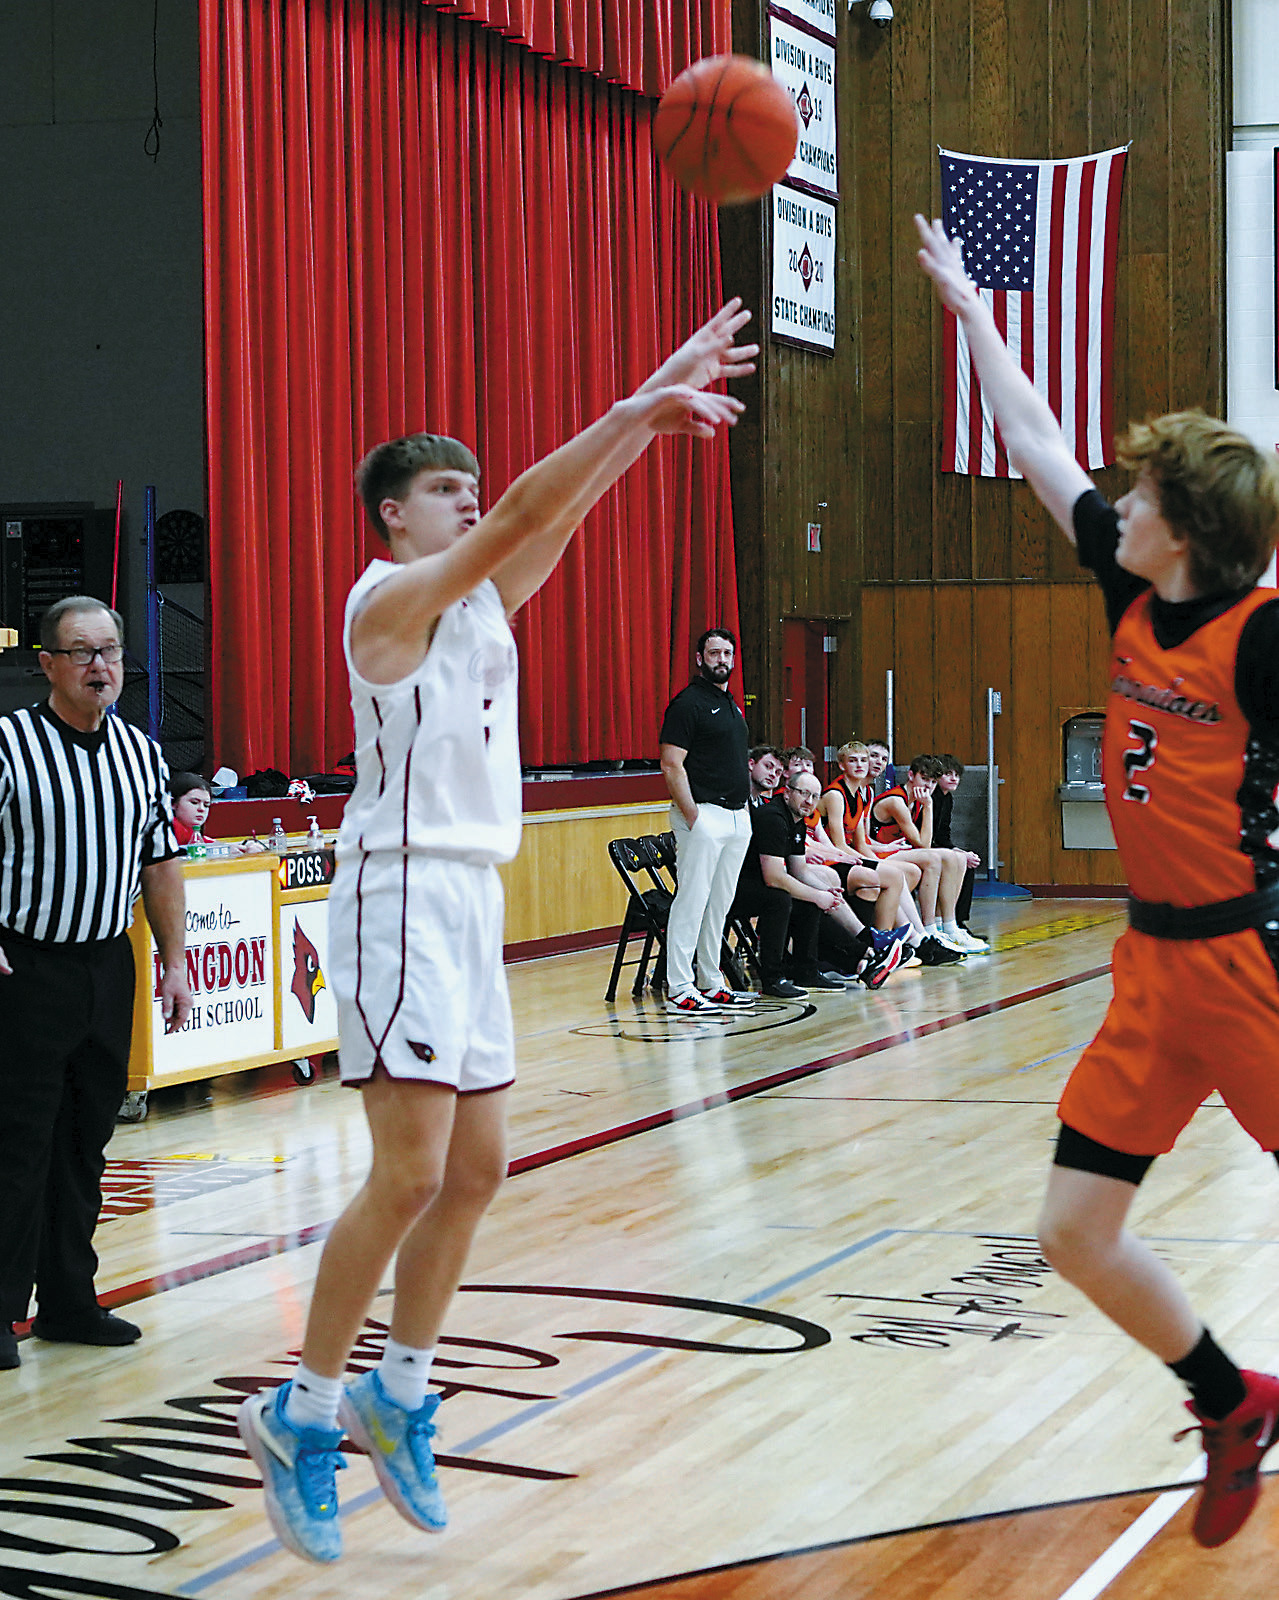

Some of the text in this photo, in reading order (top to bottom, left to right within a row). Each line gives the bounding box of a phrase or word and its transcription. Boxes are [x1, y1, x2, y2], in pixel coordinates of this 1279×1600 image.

[776, 37, 832, 85] DIVISION A BOYS
[799, 140, 835, 175] CHAMPIONS
[777, 197, 832, 237] DIVISION A BOYS
[788, 248, 825, 283] 20 20
[774, 296, 835, 335] STATE CHAMPIONS
[1121, 719, 1158, 804] 2
[287, 855, 325, 887] POSS.
[219, 903, 240, 930] to
[206, 996, 263, 1028] SCHOOL
